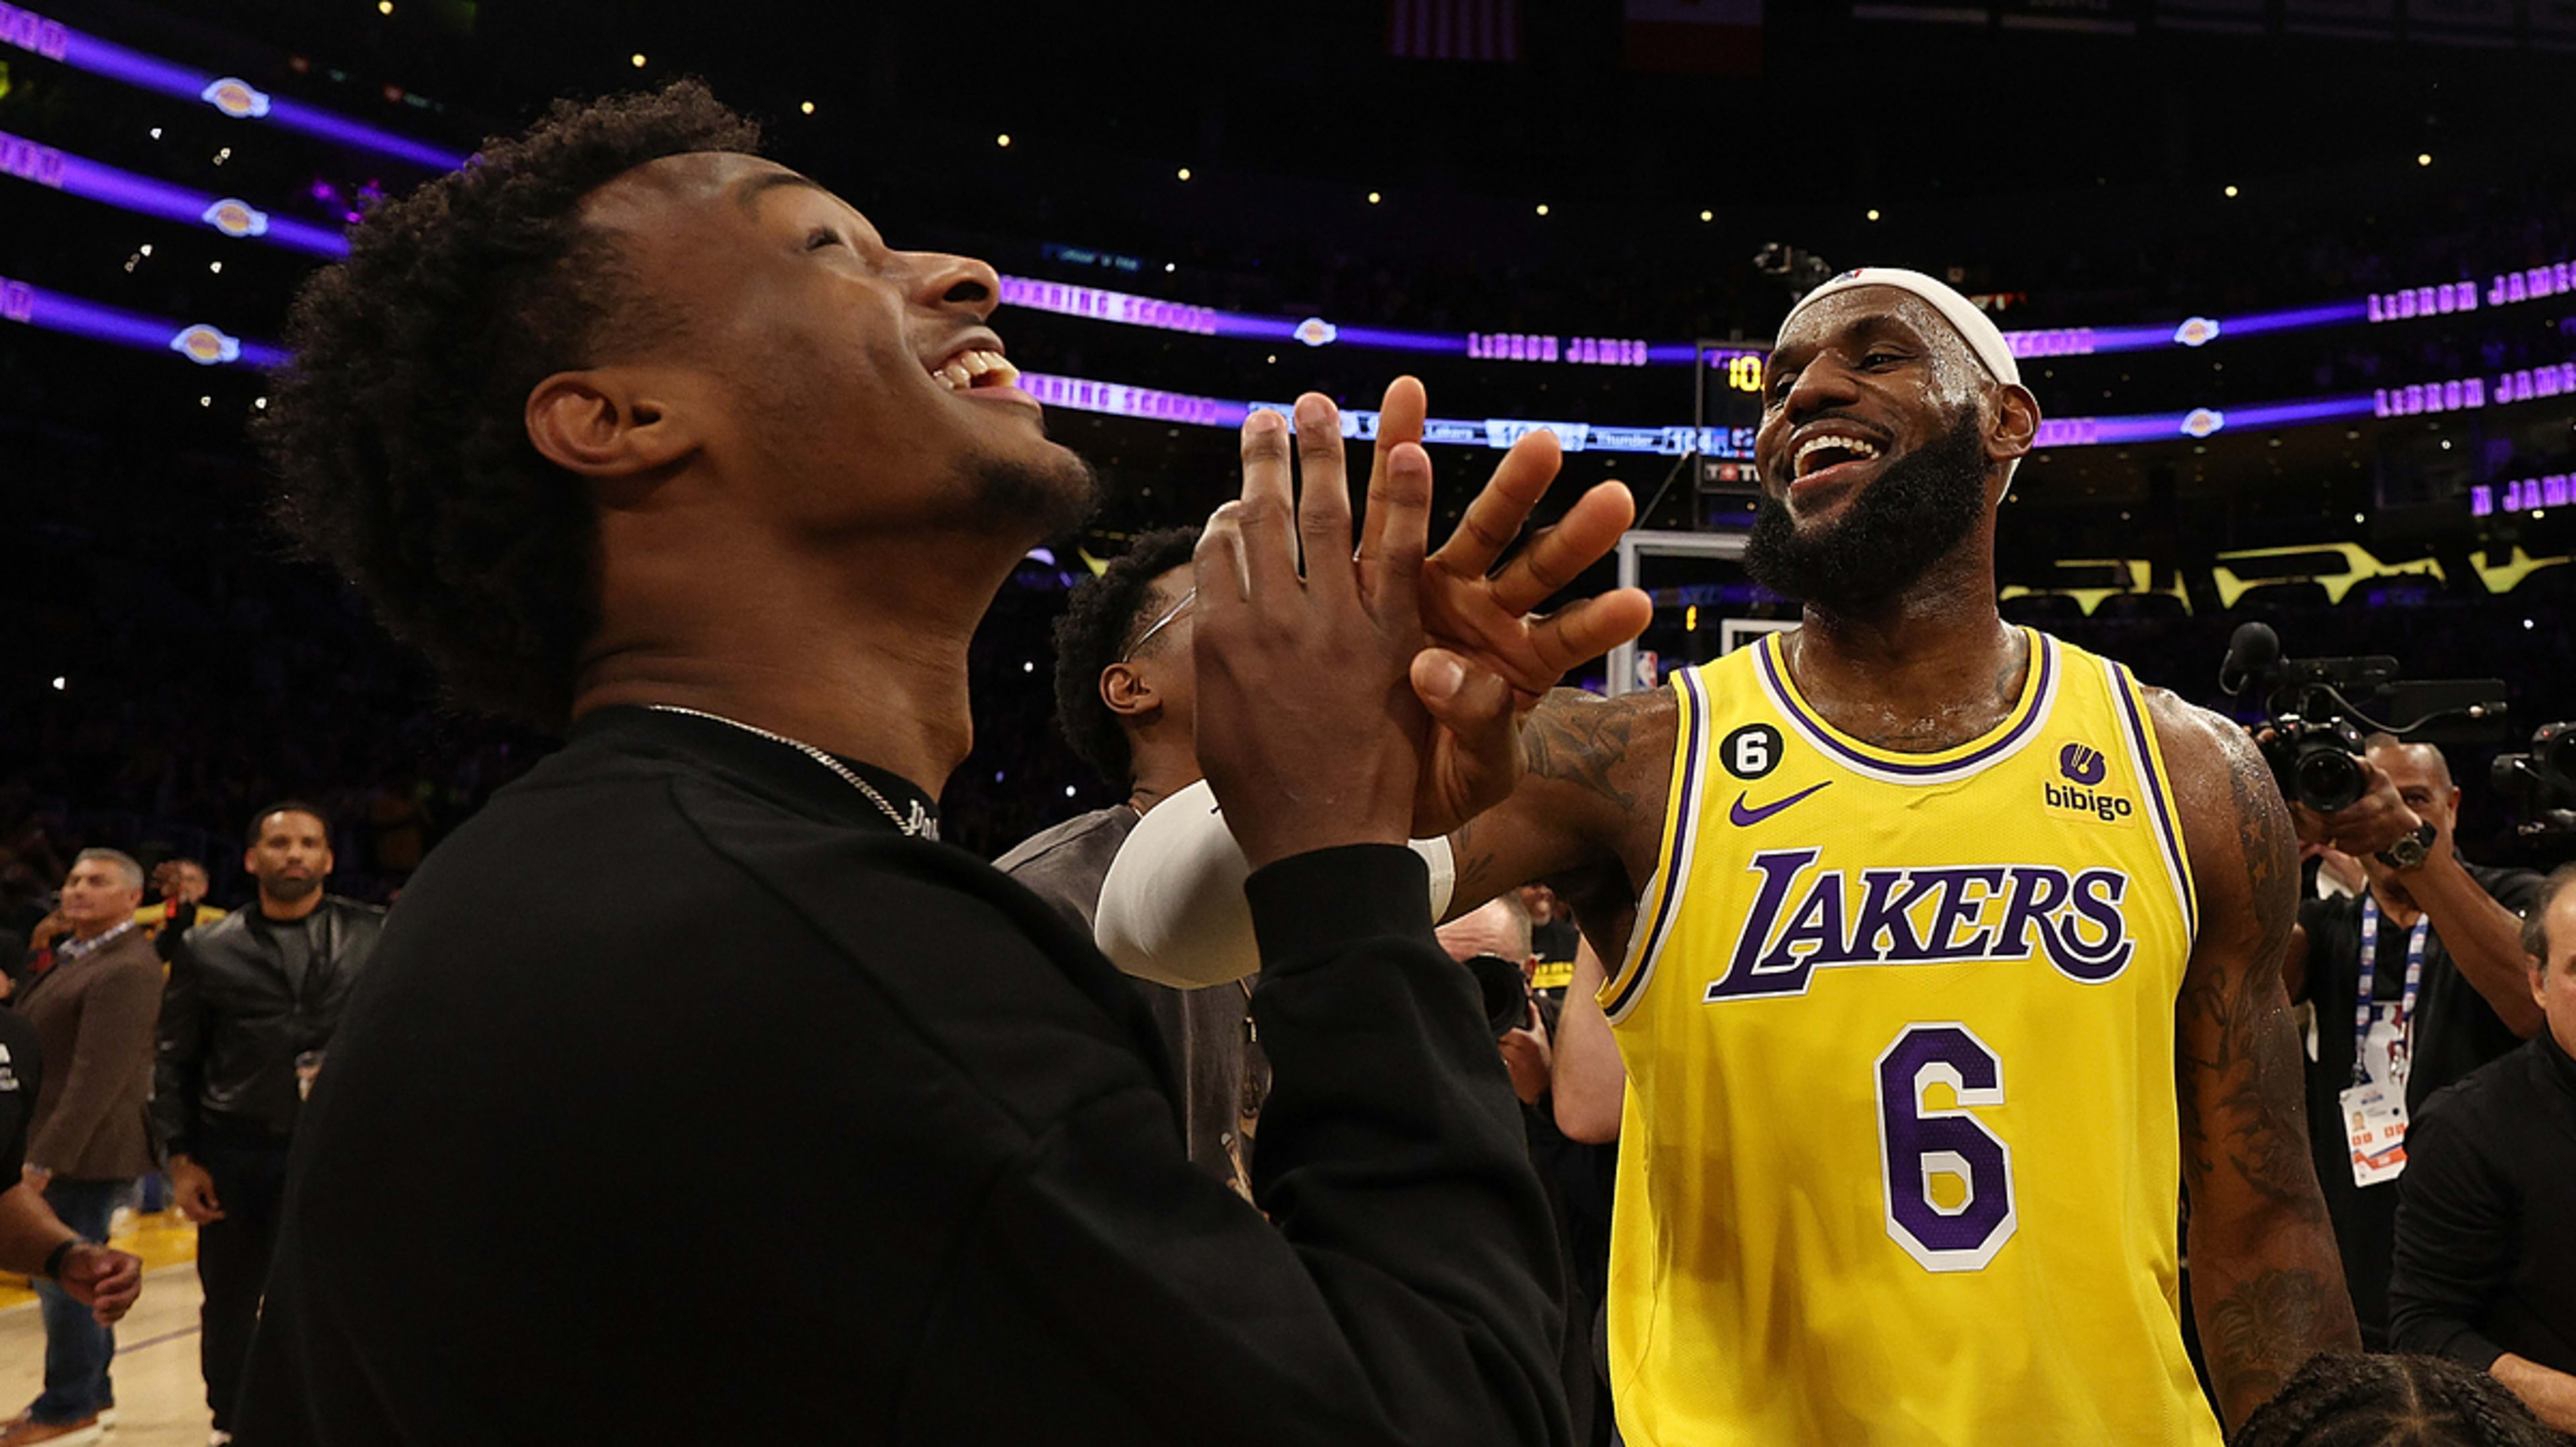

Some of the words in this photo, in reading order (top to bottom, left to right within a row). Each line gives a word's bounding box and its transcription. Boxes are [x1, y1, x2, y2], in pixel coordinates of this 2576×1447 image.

[1566, 337, 1648, 367] JAMES
[1736, 731, 1768, 773] 6
[2045, 781, 2133, 822] bibigo
[1703, 845, 2137, 1004] LAKERS
[1874, 1021, 2018, 1273] 6
